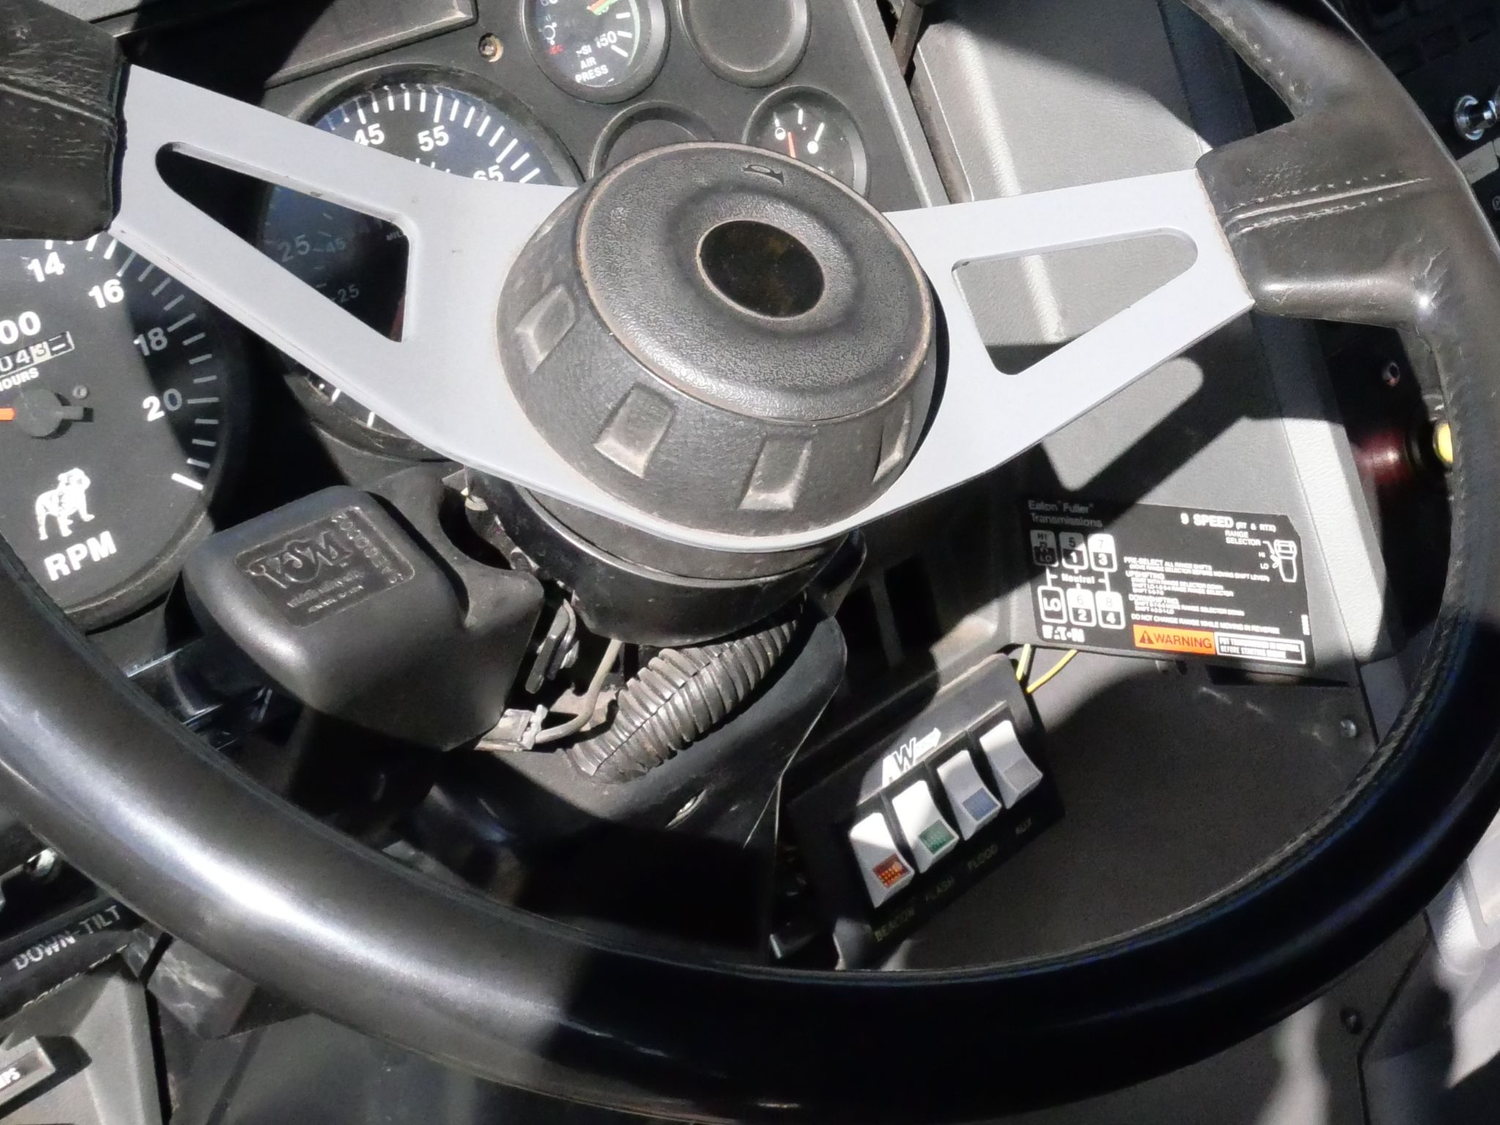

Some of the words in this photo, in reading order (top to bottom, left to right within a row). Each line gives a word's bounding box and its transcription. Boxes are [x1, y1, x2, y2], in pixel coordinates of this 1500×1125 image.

[580, 56, 597, 69] AIR
[575, 64, 609, 83] PRESS
[353, 123, 385, 146] 45
[417, 125, 449, 151] 55
[277, 234, 310, 263] 25
[325, 237, 346, 253] 45
[27, 251, 65, 282] 14
[88, 278, 125, 308] 16
[337, 284, 360, 303] 25
[133, 326, 168, 357] 18
[142, 388, 182, 422] 20
[1030, 512, 1103, 528] Transmissions
[1180, 512, 1190, 525] 9
[1192, 513, 1235, 528] SPEED
[1068, 536, 1076, 548] 5
[1224, 529, 1249, 539] RANGE
[1225, 536, 1262, 546] SELECTOR
[1097, 539, 1104, 548] 7
[43, 530, 118, 581] RPM
[1070, 551, 1078, 564] 1
[1098, 553, 1108, 566] 3
[1259, 562, 1270, 570] LO
[1060, 572, 1096, 585] Neutral
[1043, 597, 1062, 612] LO
[1076, 595, 1084, 606] 6
[1077, 608, 1088, 622] 2
[1106, 611, 1117, 624] 4
[1153, 632, 1213, 649] WARNING
[1014, 817, 1033, 837] AUX
[967, 844, 998, 871] FLOOD
[924, 876, 956, 902] FLASH
[873, 907, 916, 943] BEACON
[11, 904, 122, 971] DOWN-TILT
